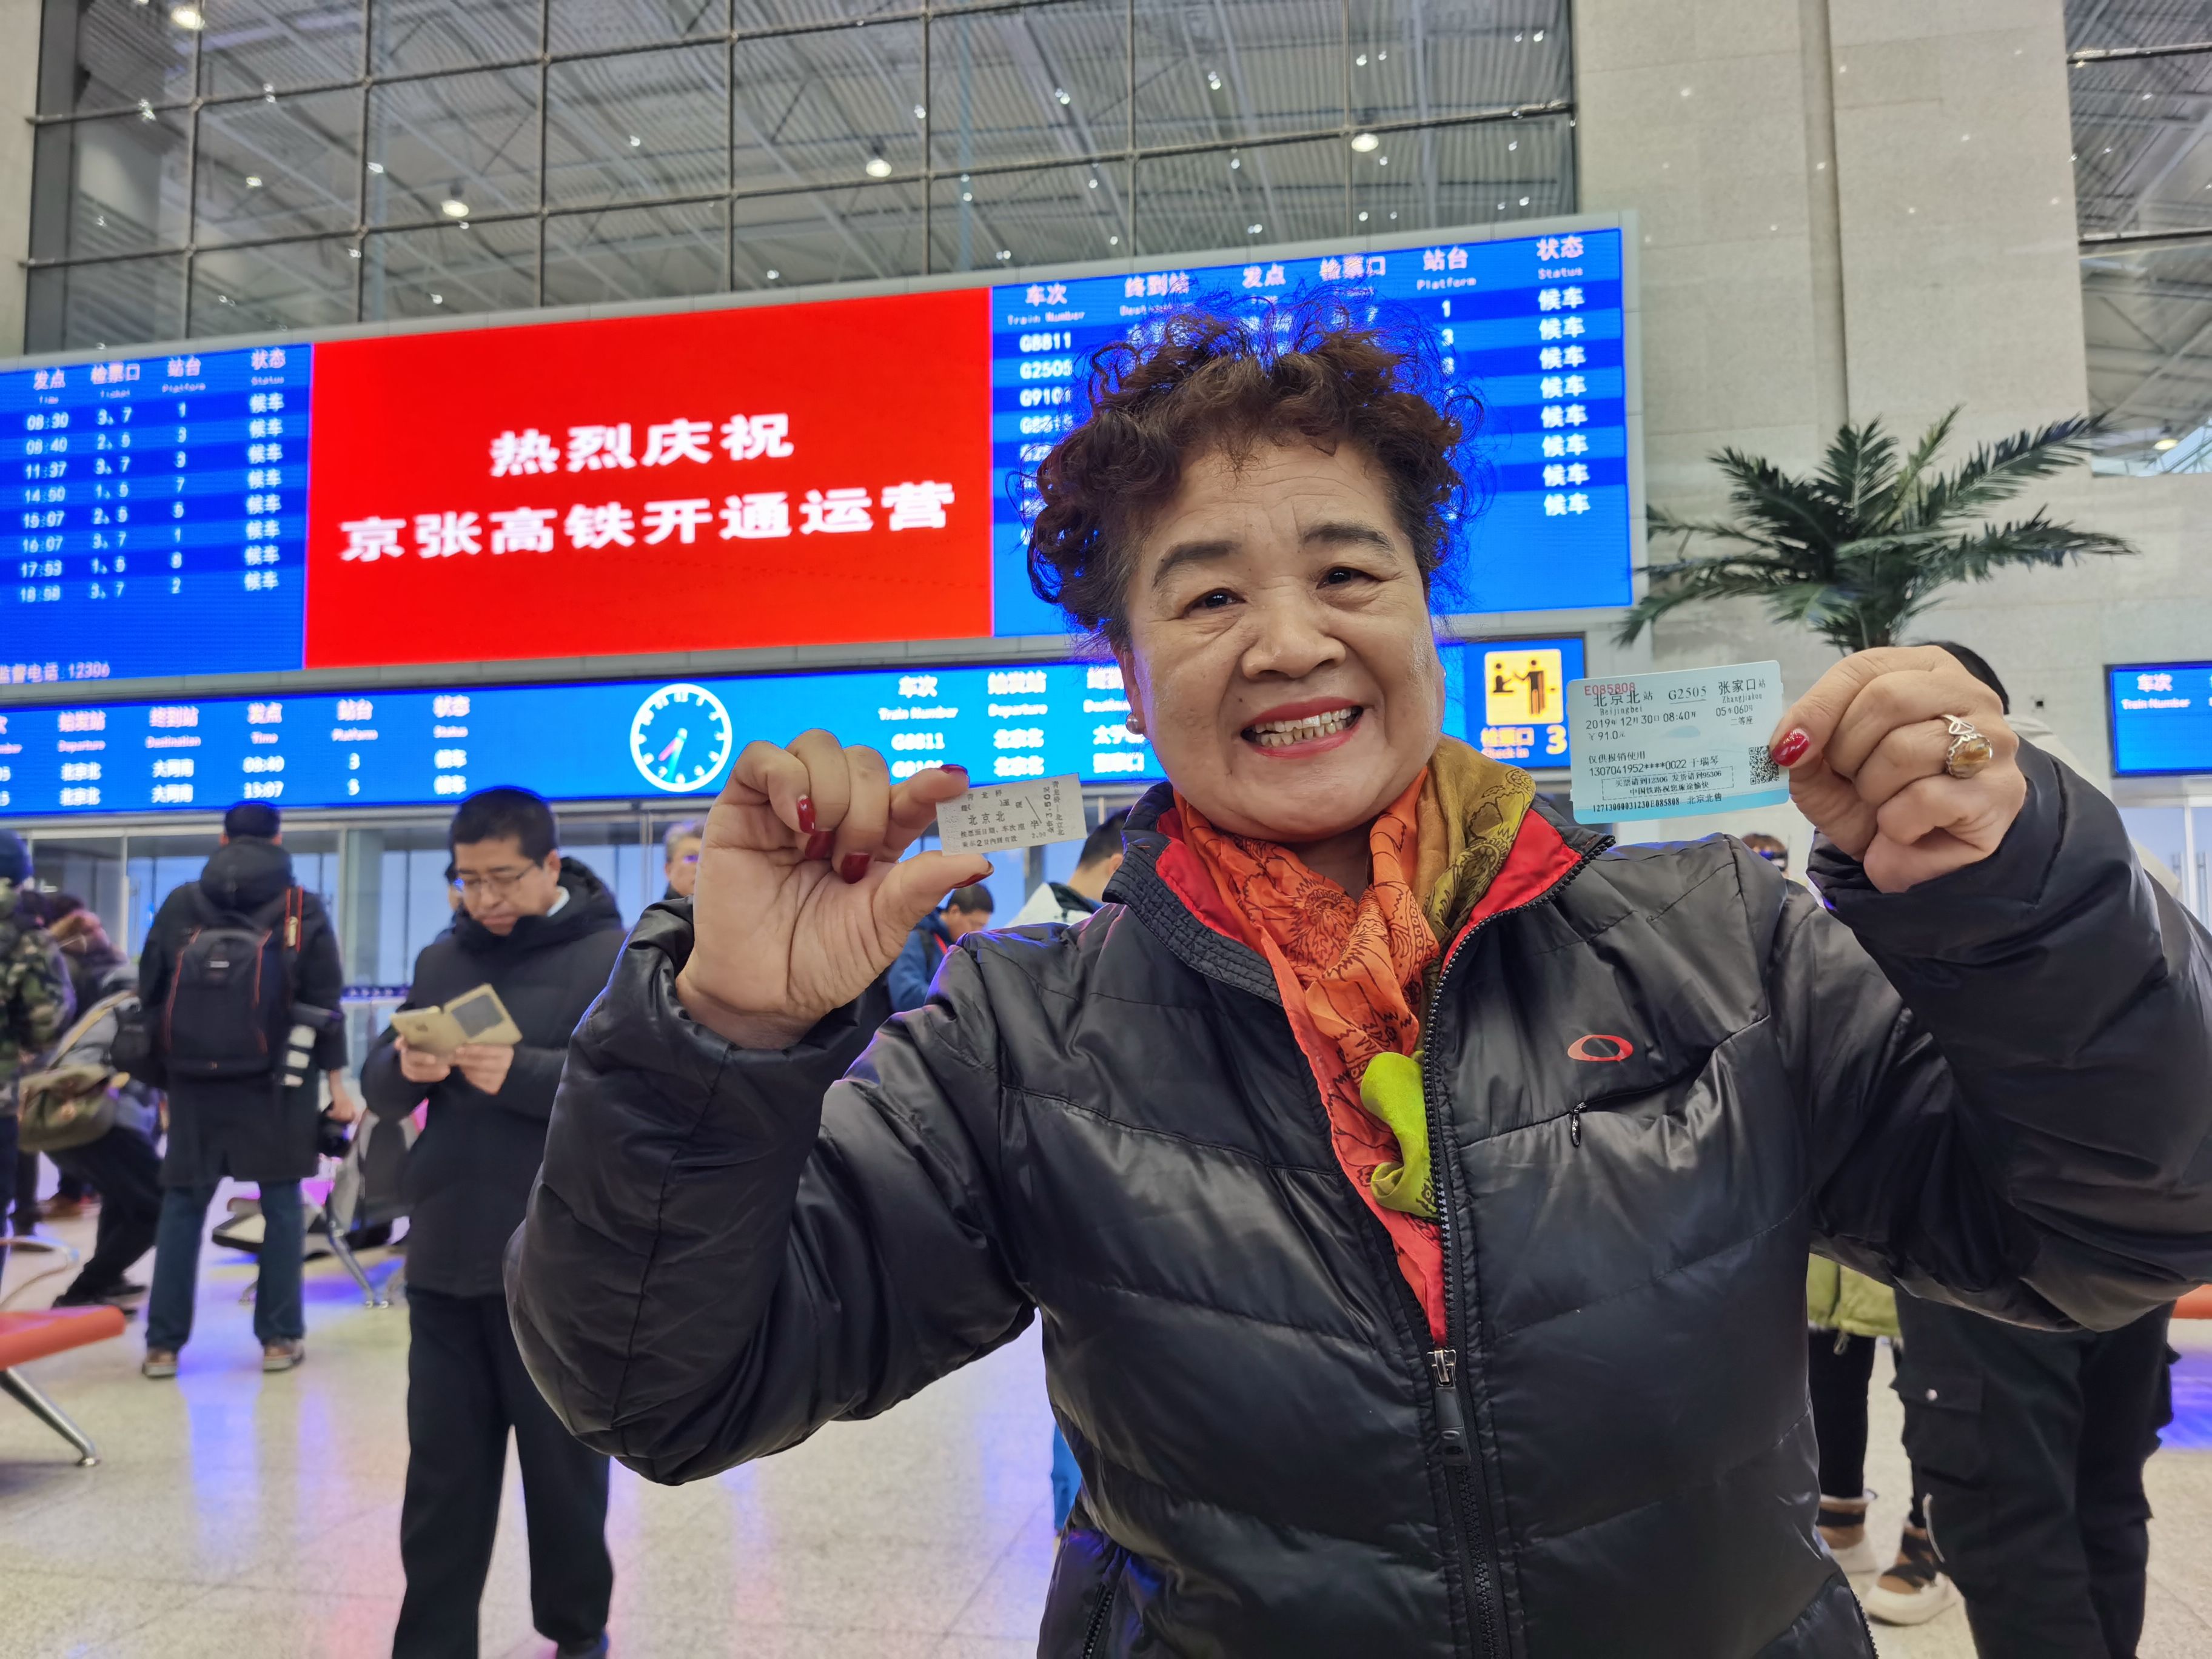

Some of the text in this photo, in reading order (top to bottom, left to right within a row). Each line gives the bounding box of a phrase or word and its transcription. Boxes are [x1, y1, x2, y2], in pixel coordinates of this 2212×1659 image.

[1025, 283, 1068, 306] 车次
[1125, 272, 1190, 298] 终到站
[1242, 263, 1285, 288] 发点
[1423, 247, 1468, 270] 站台
[1537, 236, 1584, 261] 状态
[1538, 267, 1583, 280] Status
[1020, 287, 1584, 352] G8811 1 候车
[1539, 317, 1585, 340] 候车
[33, 369, 65, 390] 发点
[167, 355, 201, 377] 站台
[251, 348, 286, 370] 状态
[1540, 346, 1586, 369] 候车
[1540, 375, 1586, 398] 候车
[1541, 404, 1587, 427] 候车
[489, 412, 794, 478] 热烈庆祝
[1542, 434, 1588, 457] 候车
[1543, 463, 1589, 486] 候车
[1544, 493, 1590, 516] 候车
[338, 480, 956, 561] 京张高铁开通运营
[1584, 682, 1635, 695] E085808
[1669, 685, 1707, 700] G2505
[1718, 679, 1766, 695] 张家口站
[1600, 692, 1762, 716] Beijingbei Zhangjiakou
[1731, 716, 1754, 726] 二等座
[1546, 725, 1567, 755] 3
[1589, 751, 1645, 764] 仅供报销使用
[968, 811, 1005, 825] 北京北
